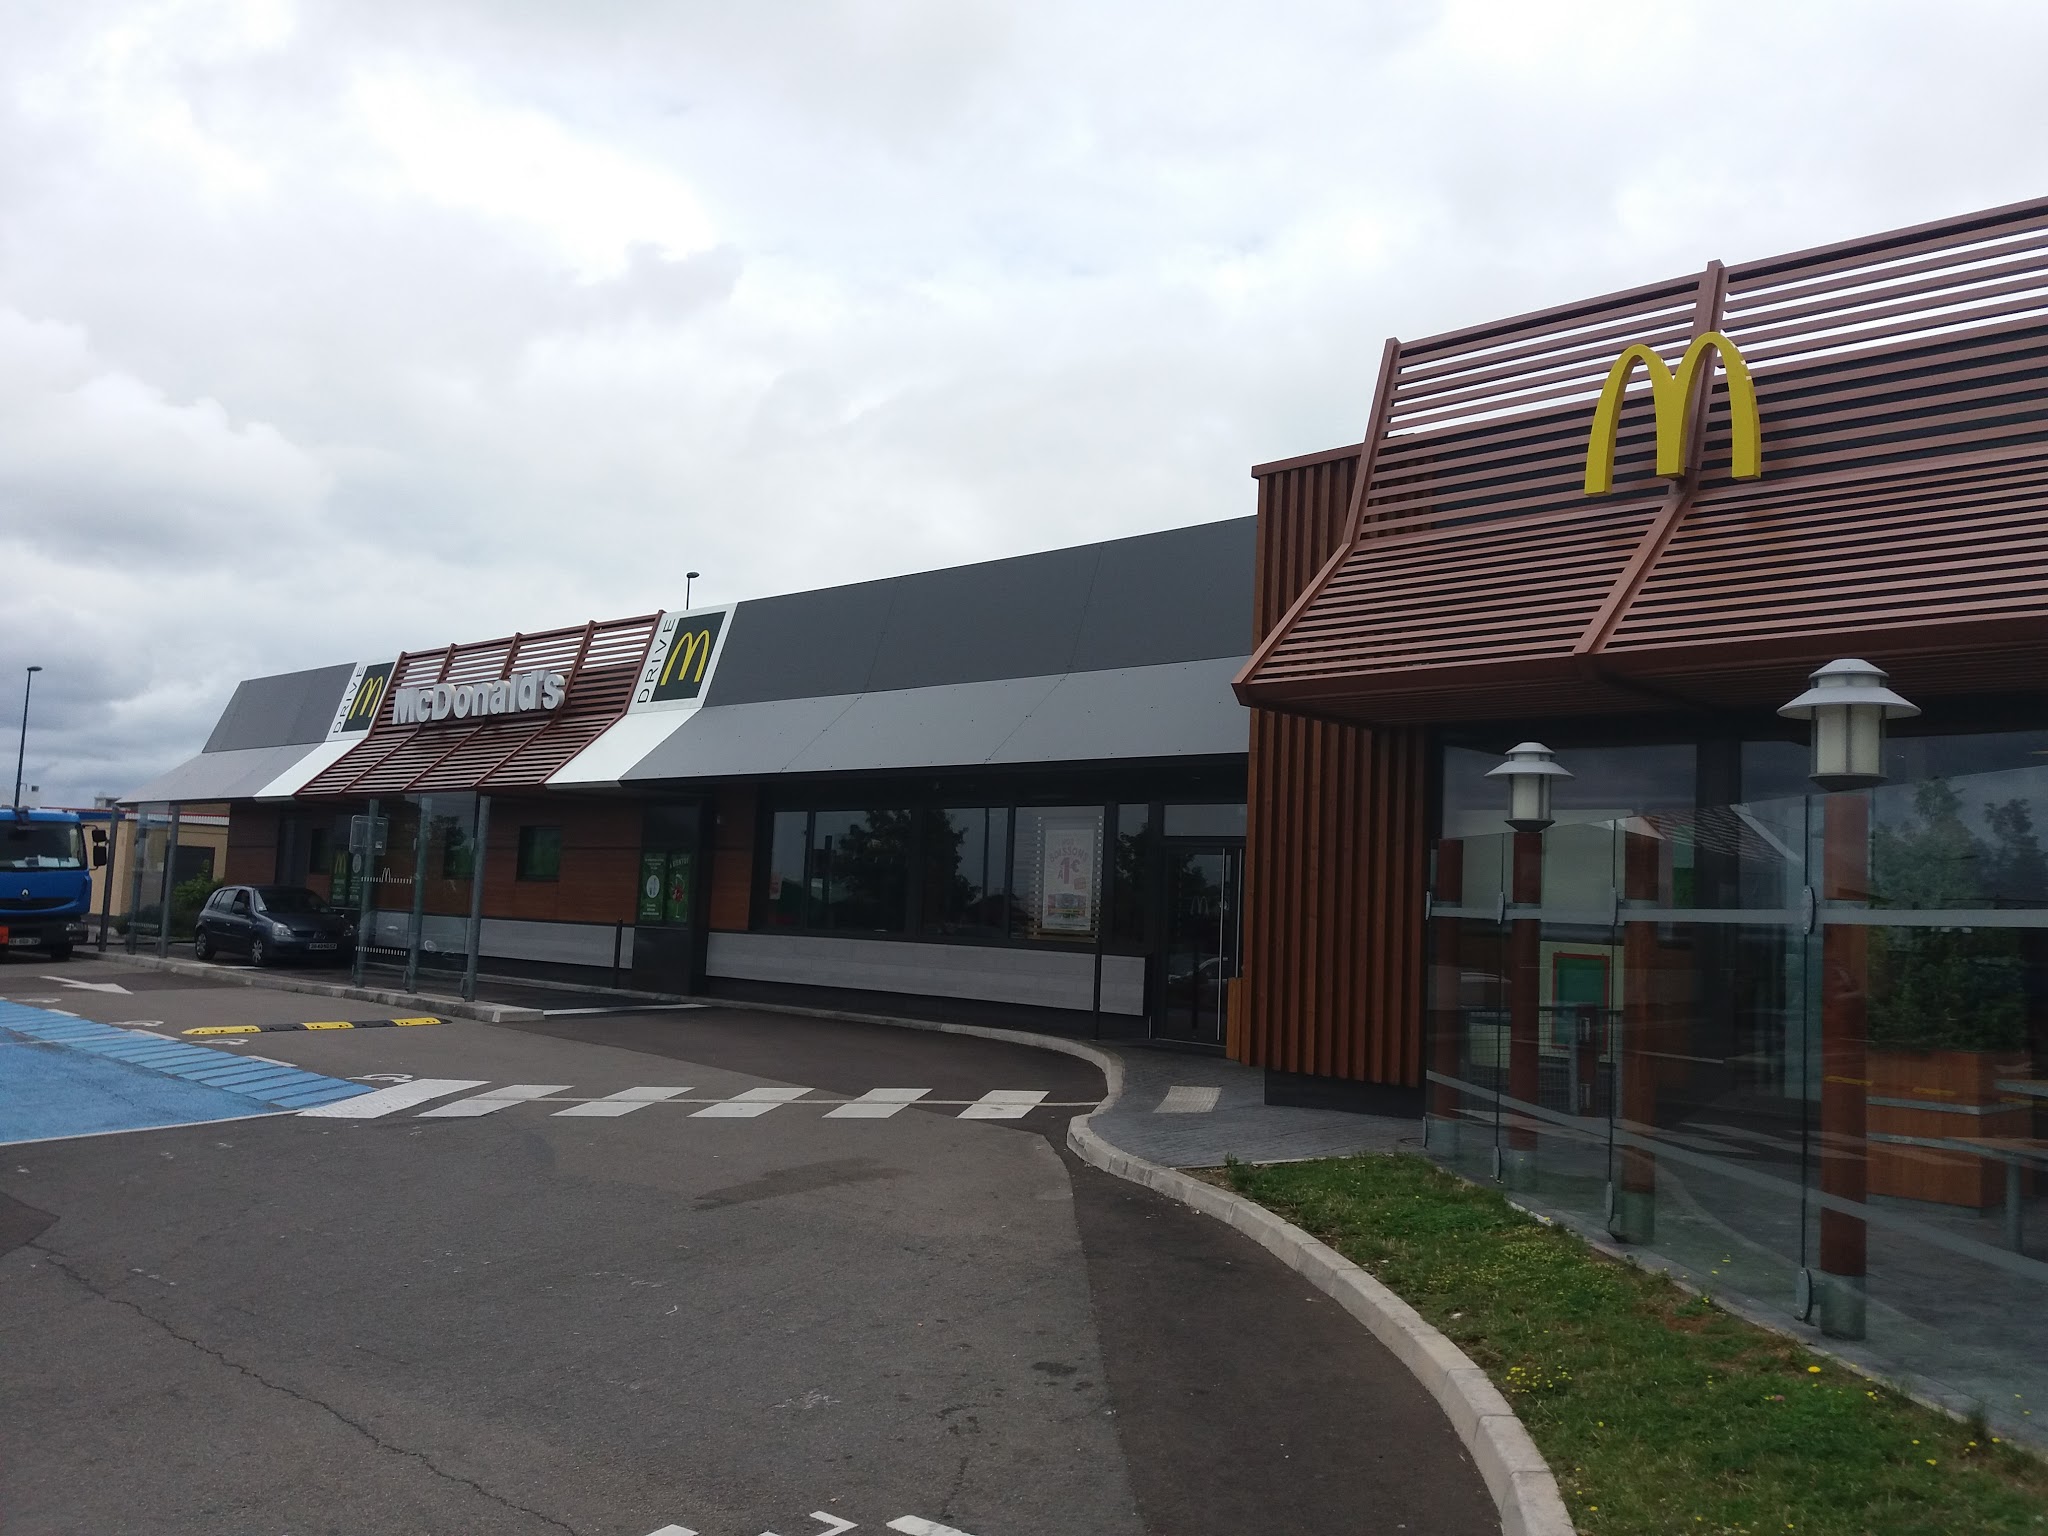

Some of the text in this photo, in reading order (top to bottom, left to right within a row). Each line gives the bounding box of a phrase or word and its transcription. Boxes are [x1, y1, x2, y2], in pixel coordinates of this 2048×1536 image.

[637, 619, 676, 703] DRIVE
[333, 666, 365, 733] DRIVE
[392, 670, 566, 725] McDonald's
